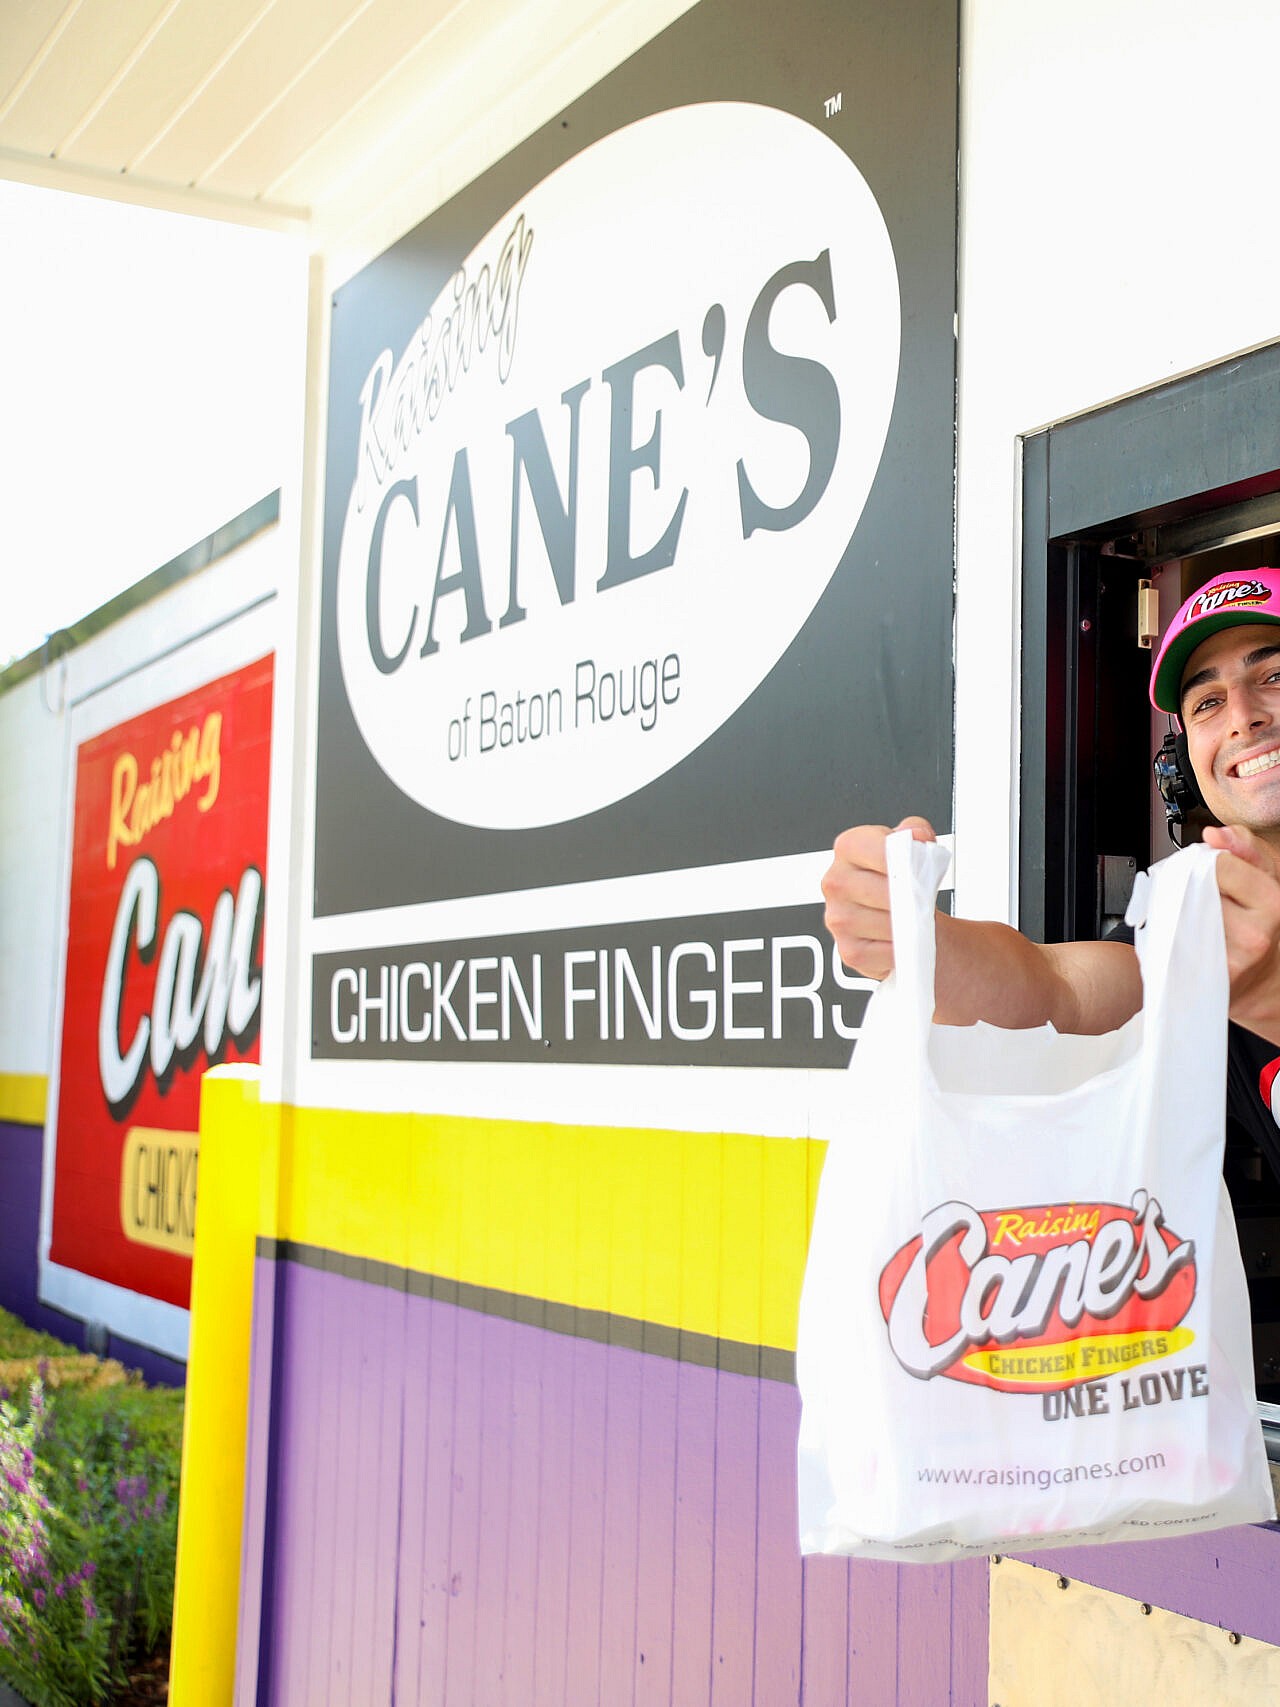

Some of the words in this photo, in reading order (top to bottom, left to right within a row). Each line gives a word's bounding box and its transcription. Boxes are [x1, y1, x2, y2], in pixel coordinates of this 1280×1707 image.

[824, 91, 842, 118] TM
[357, 212, 534, 514] Raising
[366, 248, 842, 676] CANE'S
[448, 697, 471, 762] of
[480, 691, 562, 753] Baton
[575, 653, 681, 732] Rouge
[107, 711, 221, 868] Raising
[330, 953, 542, 1044] CHICKEN
[992, 1201, 1099, 1246] Raising
[888, 1188, 1196, 1379] Cane's
[988, 1352, 1075, 1375] CHICKEN
[1081, 1337, 1168, 1367] FINGERS
[1043, 1382, 1110, 1421] ONE
[1121, 1364, 1210, 1411] LOVE
[917, 1451, 1167, 1491] www.raisingcanes.com
